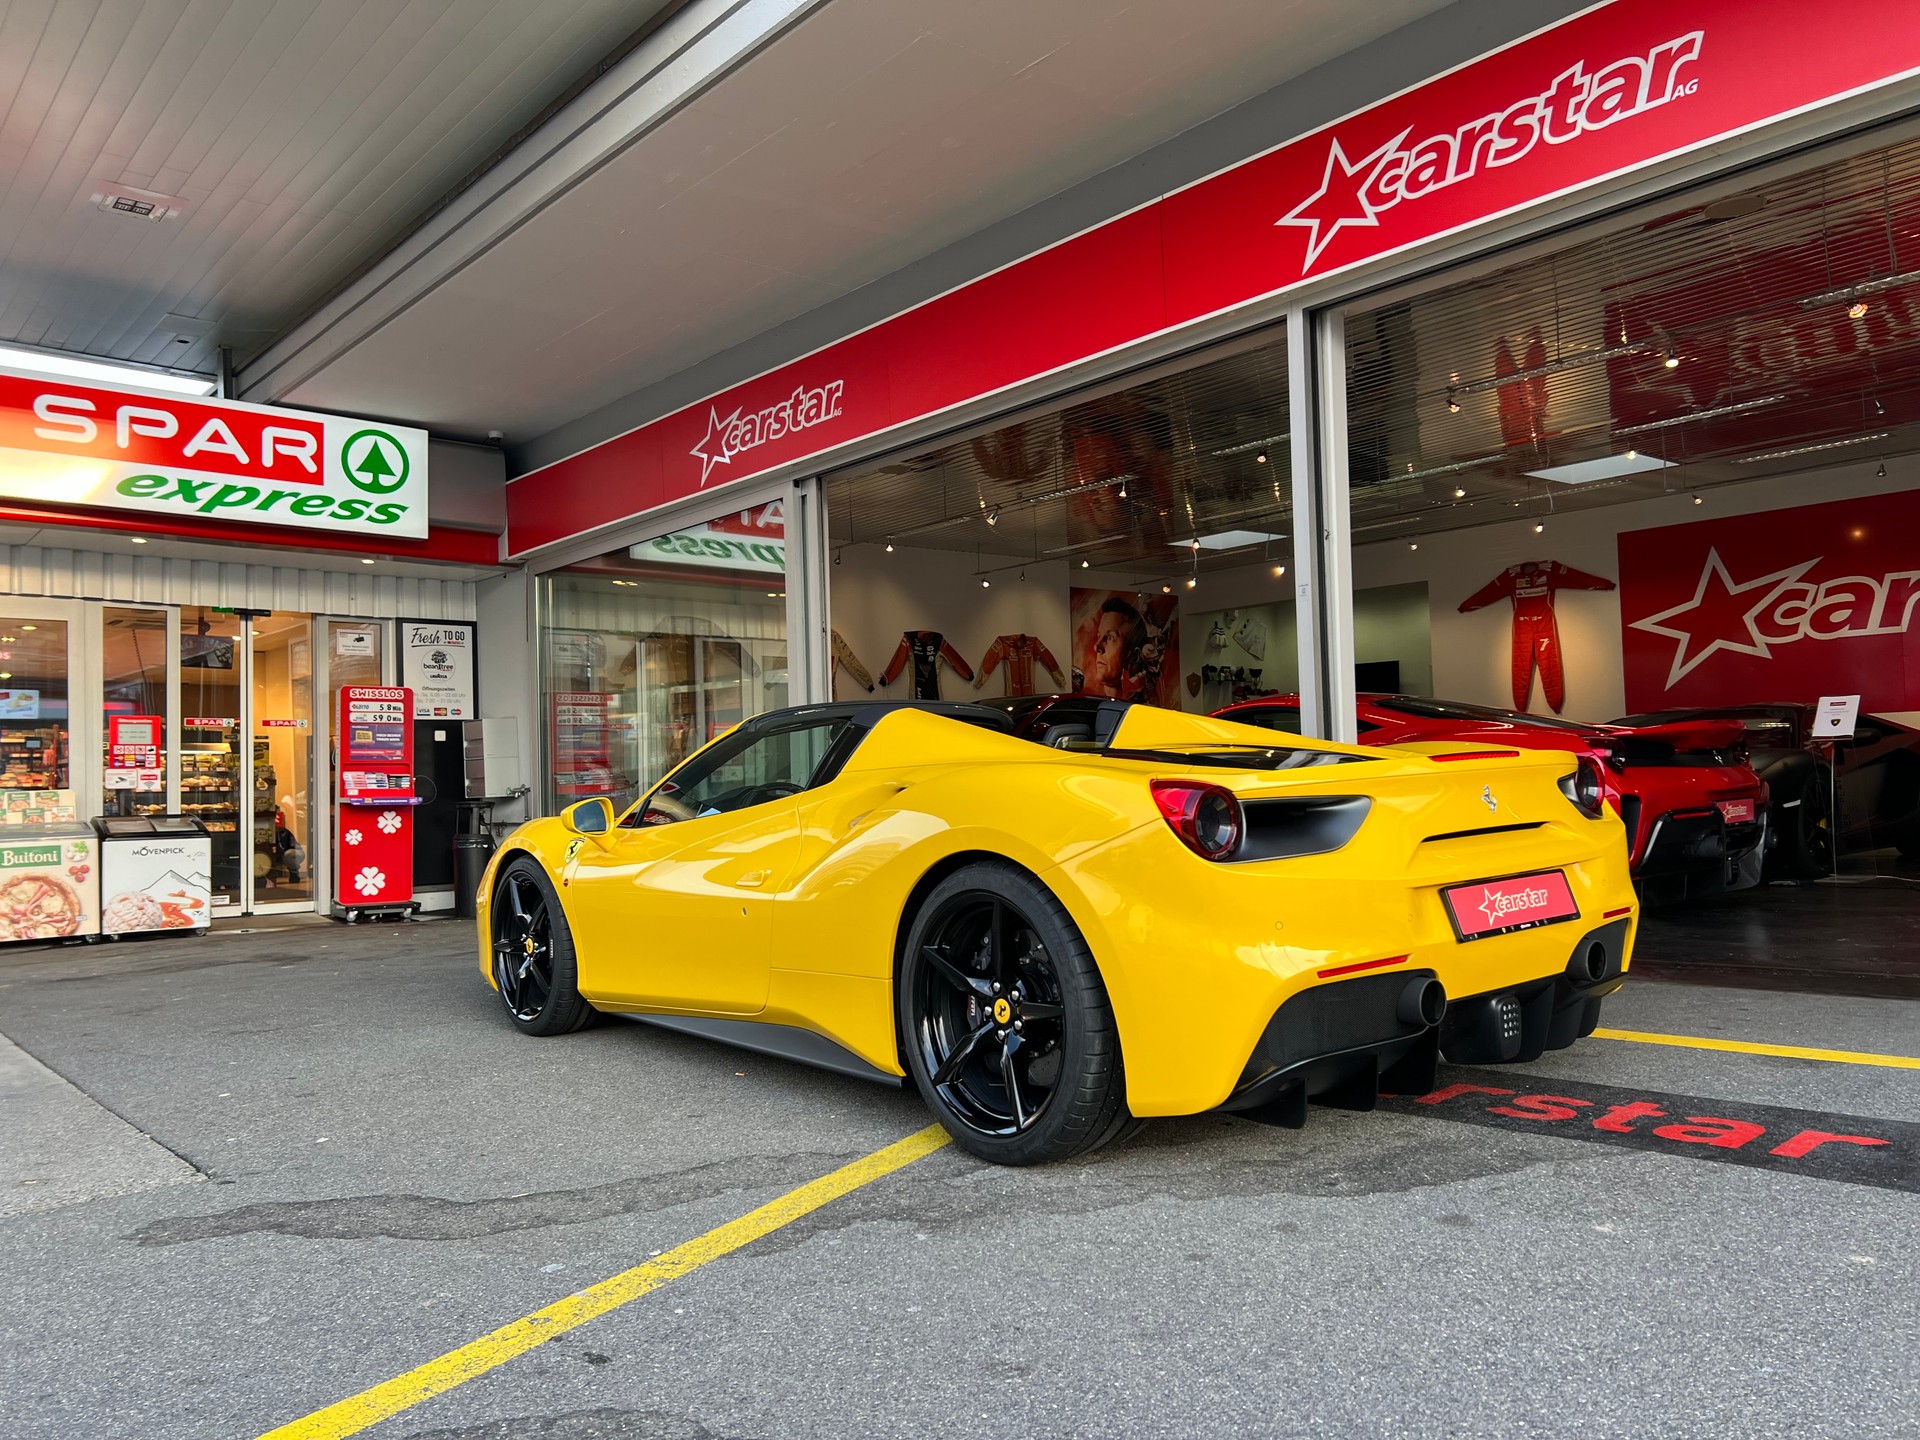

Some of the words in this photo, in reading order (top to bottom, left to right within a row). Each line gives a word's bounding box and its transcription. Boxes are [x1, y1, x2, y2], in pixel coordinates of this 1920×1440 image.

[1356, 30, 1705, 213] carstar
[1671, 78, 1699, 100] AG
[33, 393, 318, 474] SPAR
[722, 379, 844, 456] carstar
[833, 408, 842, 418] AG
[116, 474, 411, 525] express
[411, 627, 441, 644] Fresh
[443, 630, 453, 641] TO
[455, 631, 465, 641] GO
[1539, 638, 1549, 651] 7
[351, 689, 404, 699] SWISSLOS
[1, 850, 58, 867] Buitoni
[1496, 888, 1548, 913] carstar
[1376, 1083, 1891, 1158] rstar
